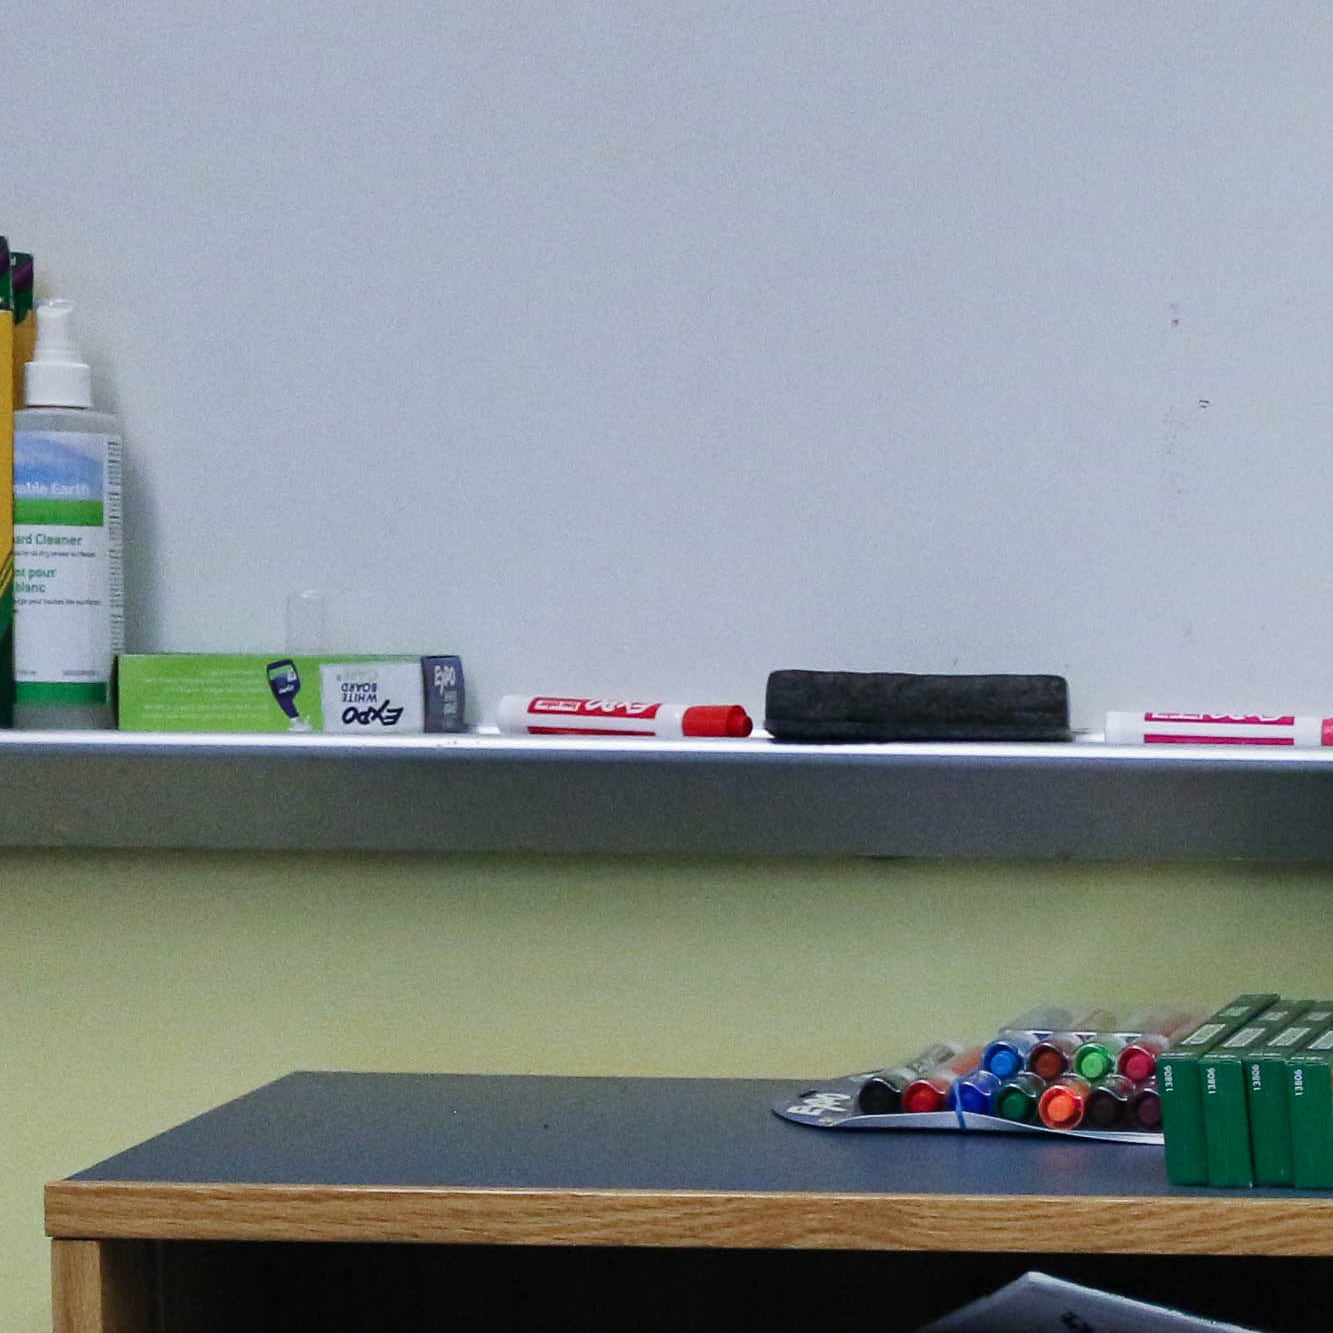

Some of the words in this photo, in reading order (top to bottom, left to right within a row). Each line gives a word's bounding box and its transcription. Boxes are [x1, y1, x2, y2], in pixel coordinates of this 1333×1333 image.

[35, 533, 82, 546] Cleaner
[341, 682, 377, 693] BOARD
[341, 692, 378, 704] WHITE
[342, 700, 404, 727] EXPO
